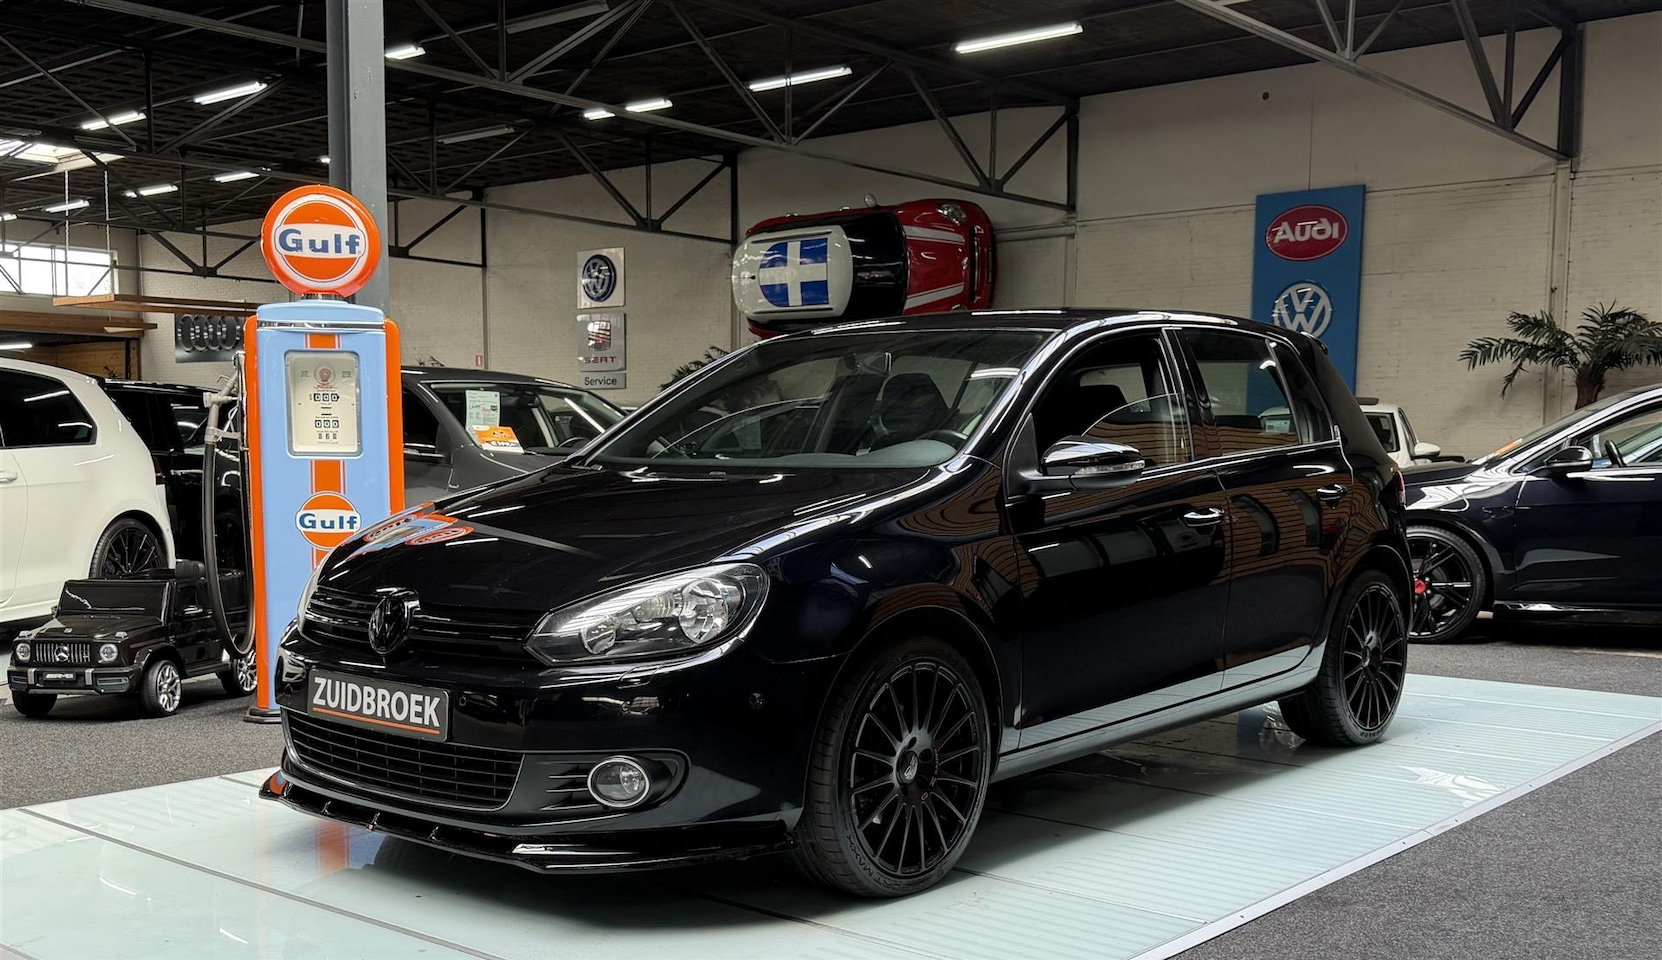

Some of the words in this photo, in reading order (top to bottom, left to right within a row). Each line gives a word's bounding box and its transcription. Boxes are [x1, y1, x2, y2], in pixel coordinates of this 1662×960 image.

[278, 228, 361, 255] Gulf
[1273, 217, 1339, 244] Audi
[584, 355, 617, 364] SEAT
[584, 376, 617, 386] Service
[298, 512, 358, 530] Gulf
[312, 676, 441, 727] ZUIDBROEK
